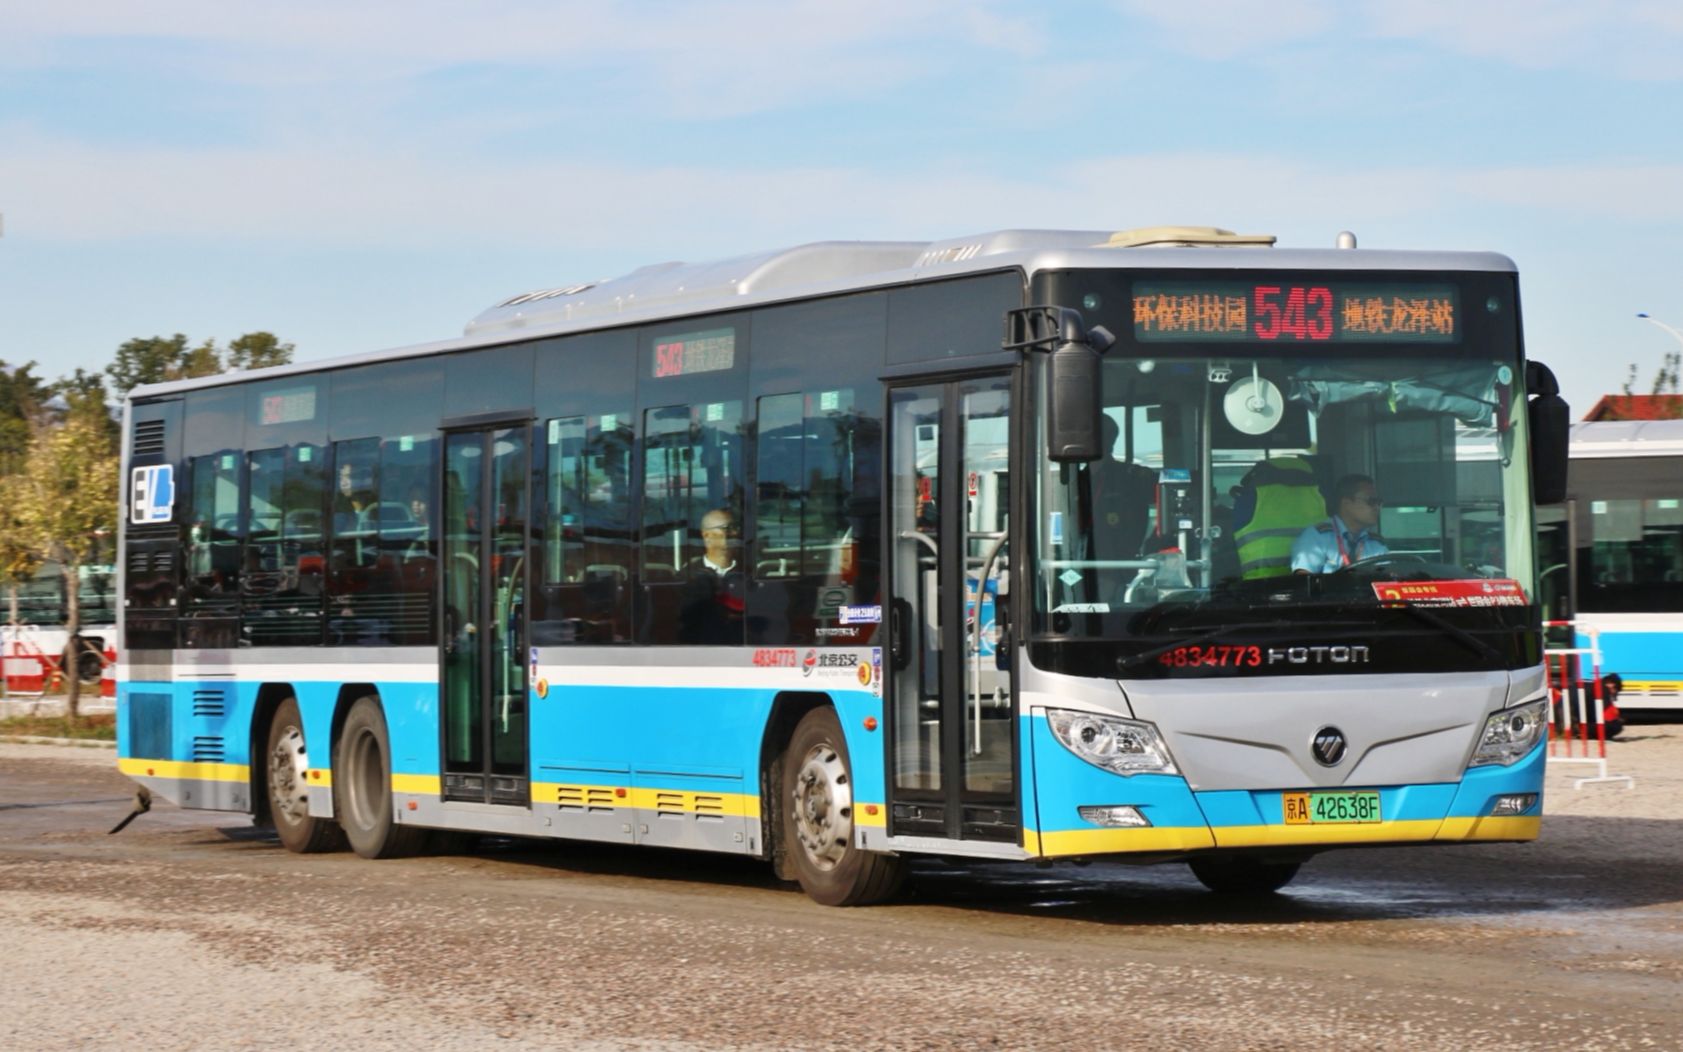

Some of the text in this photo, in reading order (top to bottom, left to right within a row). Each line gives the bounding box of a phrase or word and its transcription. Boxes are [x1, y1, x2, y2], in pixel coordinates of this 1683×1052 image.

[1254, 286, 1334, 339] 543
[752, 648, 797, 667] 4834773
[818, 653, 858, 667] 北京公交
[1158, 646, 1369, 667] 4834773 FOTON
